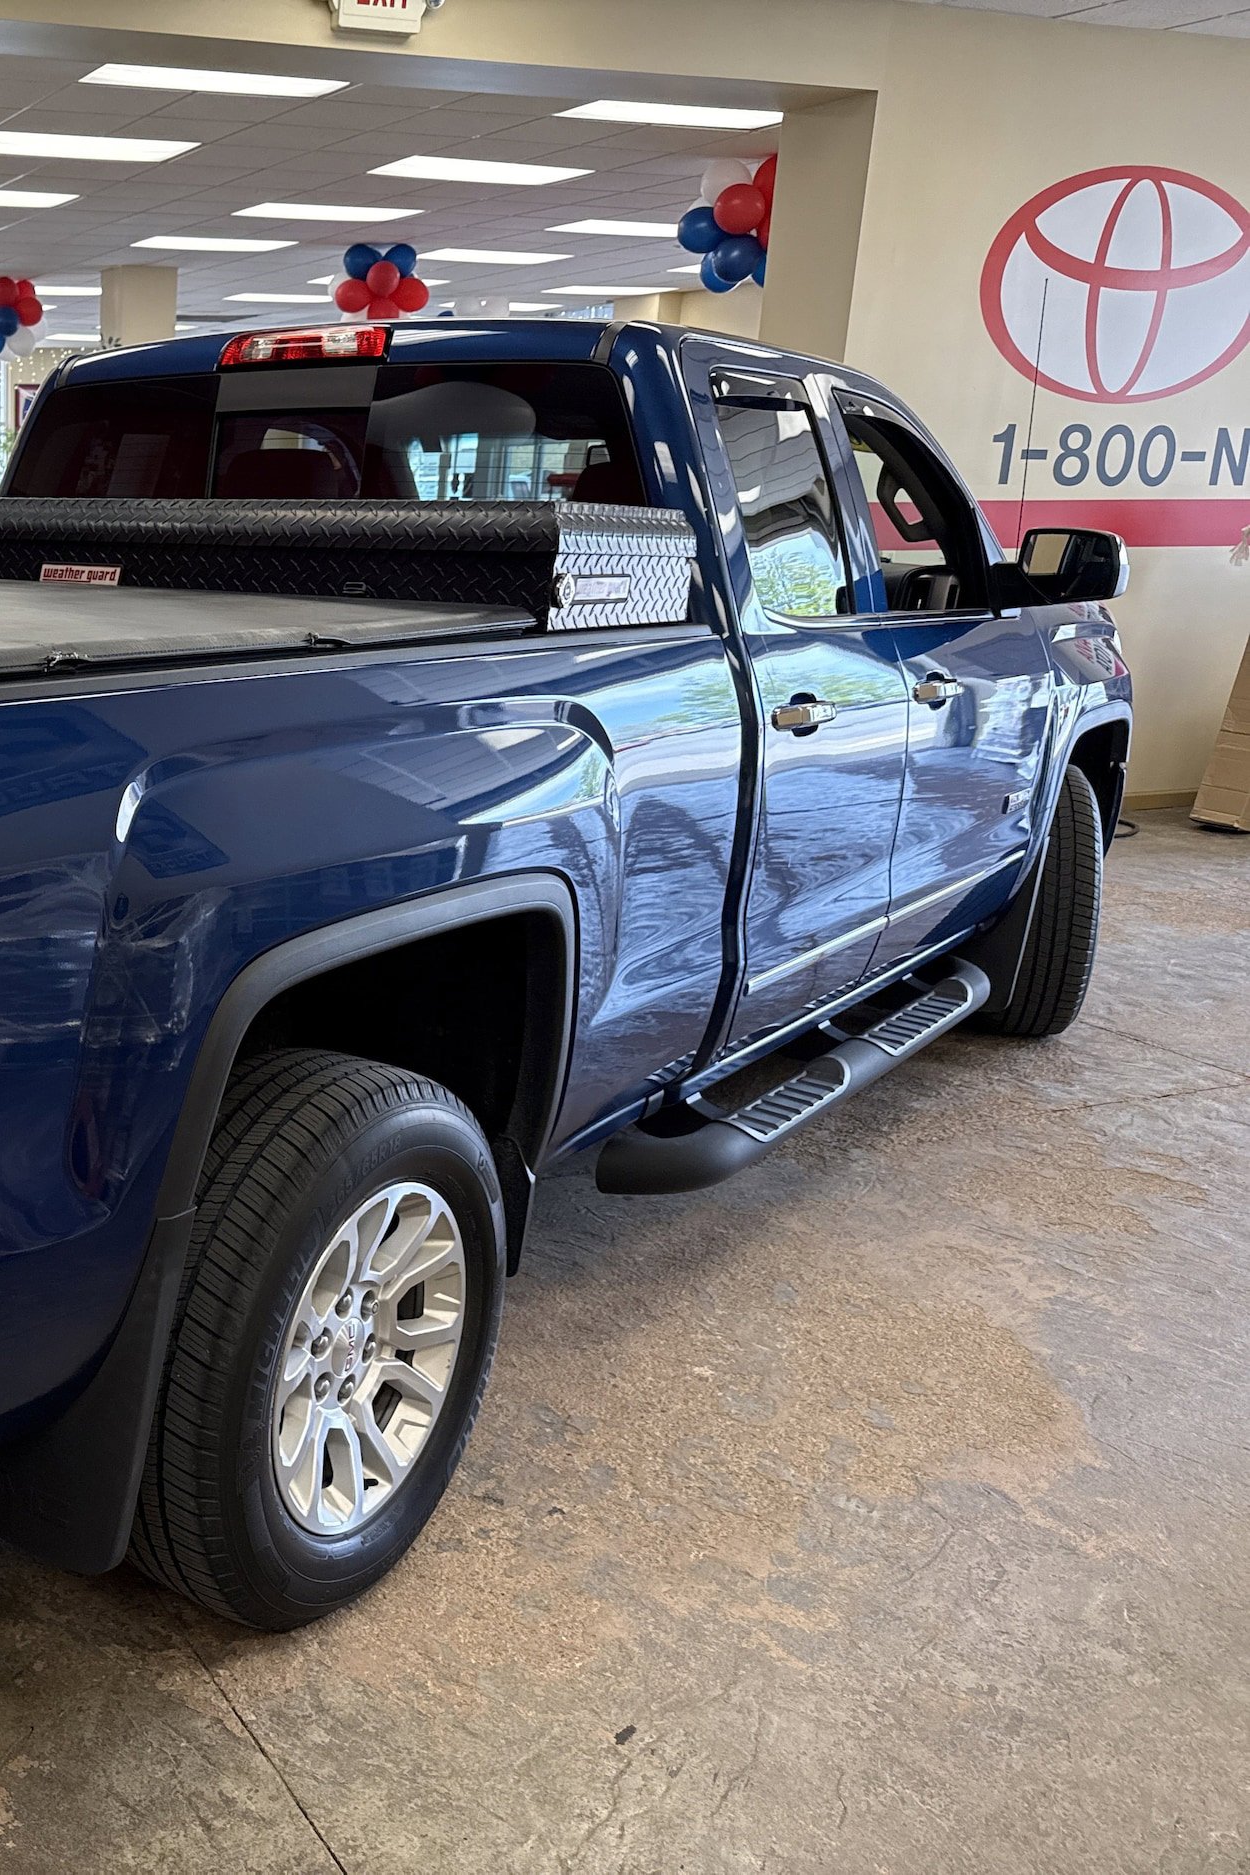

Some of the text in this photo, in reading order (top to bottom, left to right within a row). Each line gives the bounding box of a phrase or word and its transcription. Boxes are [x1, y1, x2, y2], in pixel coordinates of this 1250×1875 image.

[43, 567, 117, 582] weather guard
[344, 1323, 356, 1372] GMC
